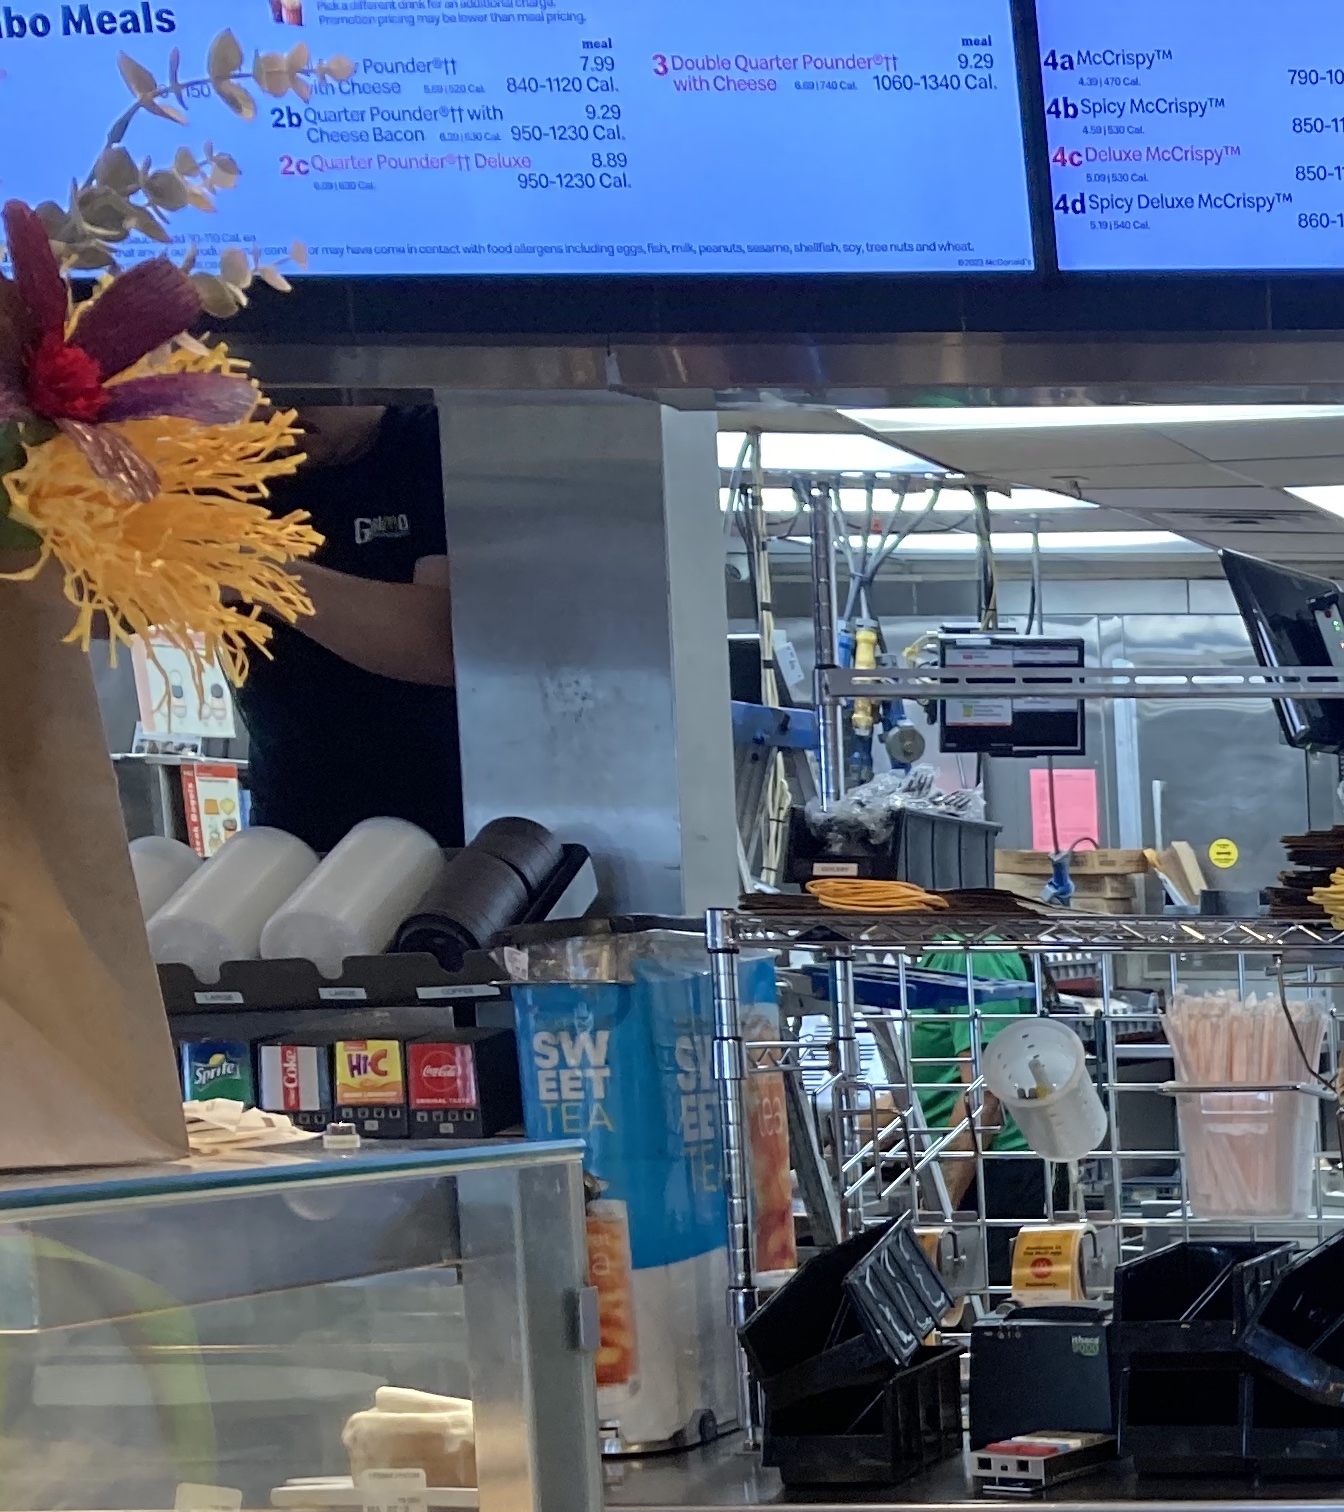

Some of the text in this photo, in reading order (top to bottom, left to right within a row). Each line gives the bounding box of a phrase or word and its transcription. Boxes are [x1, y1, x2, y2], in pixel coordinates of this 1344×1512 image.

[0, 2, 176, 38] bo Meals
[582, 38, 612, 49] meal
[961, 35, 992, 47] meal
[580, 56, 615, 73] 7.99
[652, 54, 798, 75] 3 Double Quarter
[958, 53, 994, 69] 9.29
[1043, 50, 1074, 70] 4a
[338, 80, 401, 94] Cheese
[506, 77, 619, 93] 840-1120 Cal.
[674, 75, 776, 91] with Cheese
[873, 74, 998, 91] 1060-1340 Cal.
[270, 105, 503, 128] 2b Quarter with
[585, 104, 621, 120] 9.29
[1046, 98, 1078, 118] 4b
[1081, 99, 1126, 117] Spicy
[307, 128, 369, 143] Cheese
[373, 127, 425, 142] Bacon
[510, 125, 589, 141] 950-1230
[593, 125, 626, 141] Cal.
[279, 153, 531, 175] 2c Quarter Deluxe
[592, 152, 627, 168] 8.89
[1052, 147, 1083, 167] 4c
[1085, 147, 1142, 162] Deluxe
[517, 173, 631, 189] 950-1230 Cal.
[1055, 193, 1086, 214] 4d
[1089, 194, 1133, 212] Spicy
[1138, 193, 1194, 209] Deluxe
[194, 1062, 238, 1085] Sprite
[284, 1049, 298, 1088] Coke
